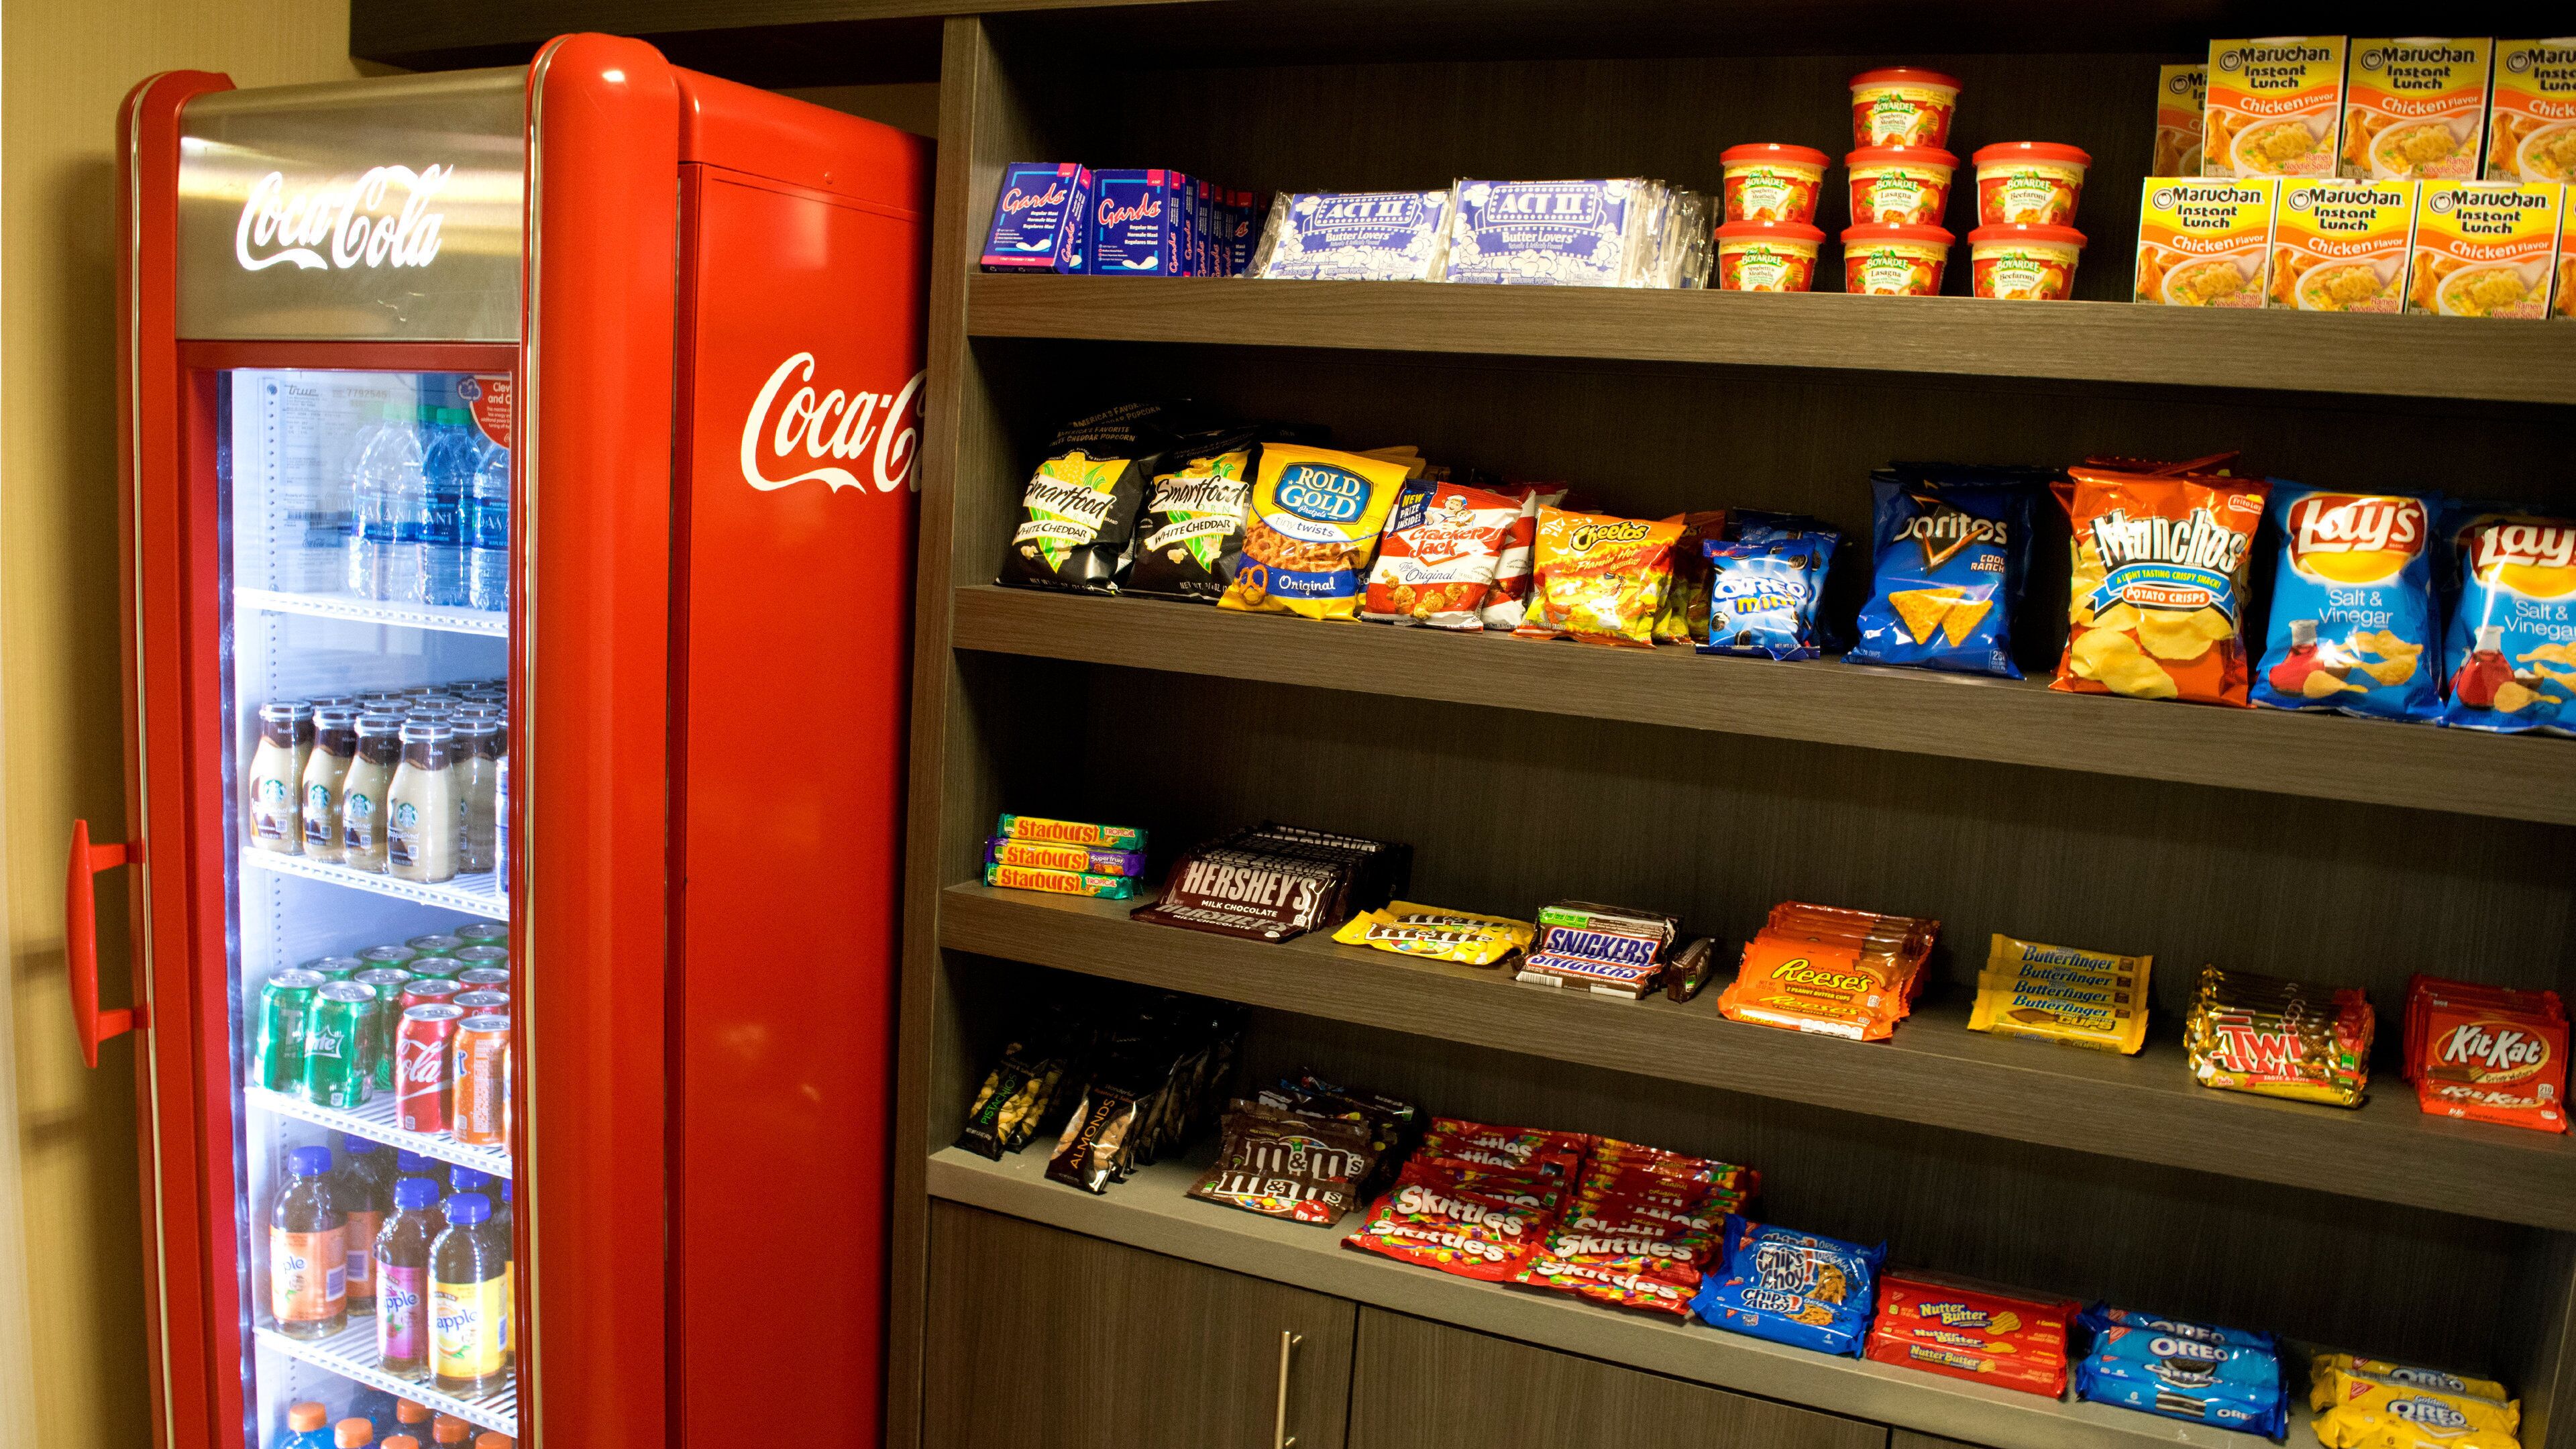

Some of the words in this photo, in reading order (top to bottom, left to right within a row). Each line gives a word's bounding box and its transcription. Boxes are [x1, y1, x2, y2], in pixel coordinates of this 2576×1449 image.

[2239, 46, 2331, 62] Maruchan
[2381, 47, 2475, 63] Maruchan
[2245, 65, 2306, 76] Instant
[2387, 65, 2451, 77] Instant
[2250, 77, 2299, 88] Lunch
[2393, 78, 2443, 89] Lunch
[1873, 101, 1916, 114] BOYARDEE
[2240, 97, 2304, 114] Chicken
[2305, 93, 2334, 105] Flavor
[2381, 97, 2447, 114] Chicken
[2448, 96, 2479, 107] Flavor
[2305, 153, 2331, 161] Ramen
[2312, 162, 2330, 171] Soup
[1745, 177, 1786, 189] BOYARDEE
[1876, 180, 1919, 191] BOYARDEE
[2006, 179, 2051, 191] BOYARDEE
[1002, 182, 1067, 215] Gards
[1498, 193, 1553, 213] ACT
[1553, 193, 1585, 213] II
[1880, 191, 1911, 200] Lasagna
[2010, 191, 2046, 201] Beefaroni
[2173, 186, 2261, 203] Maruchan
[2308, 189, 2402, 207] Maruchan
[2451, 190, 2546, 209] Maruchan
[236, 164, 453, 270] Coca-Cola
[1098, 193, 1162, 229] Gards
[1325, 201, 1376, 218] ACT
[1375, 201, 1407, 217] II
[2178, 205, 2237, 217] Instant
[2314, 205, 2377, 219] Instant
[2456, 209, 2522, 222] Instant
[2183, 217, 2231, 228] Lunch
[2319, 217, 2369, 231] Lunch
[2461, 221, 2512, 233] Lunch
[1326, 231, 1357, 242] Butter
[1358, 231, 1390, 240] Lovers
[1502, 231, 1537, 244] Butter
[1538, 231, 1572, 244] Lovers
[2172, 235, 2235, 254] Chicken
[2235, 234, 2264, 246] Flavor
[2308, 236, 2372, 256] Chicken
[2373, 237, 2404, 250] Flavor
[2450, 239, 2516, 259] Chicken
[2518, 241, 2549, 253] Flavor
[1741, 255, 1782, 266] BOYARDEE
[1871, 269, 1901, 278] Lasagna
[284, 384, 319, 396] true
[488, 394, 503, 404] and
[1297, 466, 1360, 494] ROLD
[1026, 472, 1116, 519] Smartfood
[1150, 475, 1250, 509] Smartfood
[1402, 494, 1426, 507] NEW
[1281, 484, 1357, 519] GOLD
[1298, 504, 1327, 518] Pretzels
[1400, 504, 1420, 519] PRIZE
[1042, 523, 1087, 539] CHEDDAR
[1275, 516, 1296, 528] tiny
[1296, 520, 1335, 538] twists
[1397, 515, 1421, 530] INSIDE!
[1893, 512, 2008, 545] Doritos
[2298, 498, 2420, 553] Lay's
[1154, 527, 1185, 546] WHITE
[1185, 519, 1231, 533] CHEDDAR
[1409, 527, 1484, 541] Cracker
[1572, 522, 1649, 551] Cheetos
[2092, 508, 2248, 574] Munchos
[1409, 539, 1458, 558] Jack
[1399, 561, 1413, 572] The
[1576, 553, 1616, 572] Flamin'
[1617, 548, 1642, 560] Hot
[1970, 562, 2005, 572] RANCH
[1980, 554, 2005, 565] COOL
[1279, 574, 1336, 596] Original
[1405, 568, 1457, 584] Original
[2142, 570, 2170, 579] TASTING
[2172, 570, 2196, 582] CRISPY
[2197, 576, 2222, 589] SNACK!
[1737, 594, 1797, 614] mini
[2127, 589, 2165, 603] POTATO
[2169, 590, 2206, 603] CRISPS
[2328, 589, 2365, 607] Salt
[2319, 608, 2394, 629] Vinegar
[2515, 601, 2552, 621] Salt
[1018, 820, 1099, 843] Starburst
[1104, 827, 1135, 837] TROPICAL
[1007, 846, 1088, 869] Starburst
[1090, 855, 1124, 864] Superfruit
[1001, 869, 1081, 892] Starburst
[1086, 877, 1117, 887] TROPICAL
[1182, 860, 1318, 912] HERSHEY'S
[1201, 900, 1222, 909] MILK
[1224, 904, 1278, 917] CHOCOLATE
[1155, 904, 1292, 932] HERSHEY'S
[1548, 928, 1656, 963] SNICKERS
[2022, 945, 2114, 970] Butterfinger
[1531, 955, 1641, 979] SNICKERS
[1772, 959, 1874, 992] Reese's
[2019, 964, 2112, 986] Butterfinger
[1814, 991, 1835, 999] BUTTER
[2014, 979, 2110, 1003] Butterfinger
[1759, 996, 1858, 1015] Reese's
[2012, 994, 2110, 1017] Butterfinger
[2057, 1015, 2114, 1031] CUPS
[2443, 1024, 2543, 1069] KitKat
[981, 1073, 1017, 1125] PISTACHIOS
[1069, 1098, 1115, 1169] ALMONDS
[1395, 1185, 1524, 1237] Skittles
[1370, 1220, 1506, 1263] Skittles
[1554, 1234, 1694, 1260] Skittles
[1757, 1246, 1805, 1273] Chips
[1536, 1260, 1680, 1299] Skittles
[1741, 1289, 1791, 1301] Chips
[1919, 1303, 1966, 1317] Nutter
[1941, 1311, 1988, 1325] Butter
[1914, 1329, 1960, 1338] Nutter
[1911, 1345, 1945, 1360] Nutter
[1945, 1352, 1980, 1367] Butter
[2149, 1336, 2229, 1362] OREO
[2414, 1395, 2449, 1409] Golden
[2386, 1399, 2467, 1428] OREO
